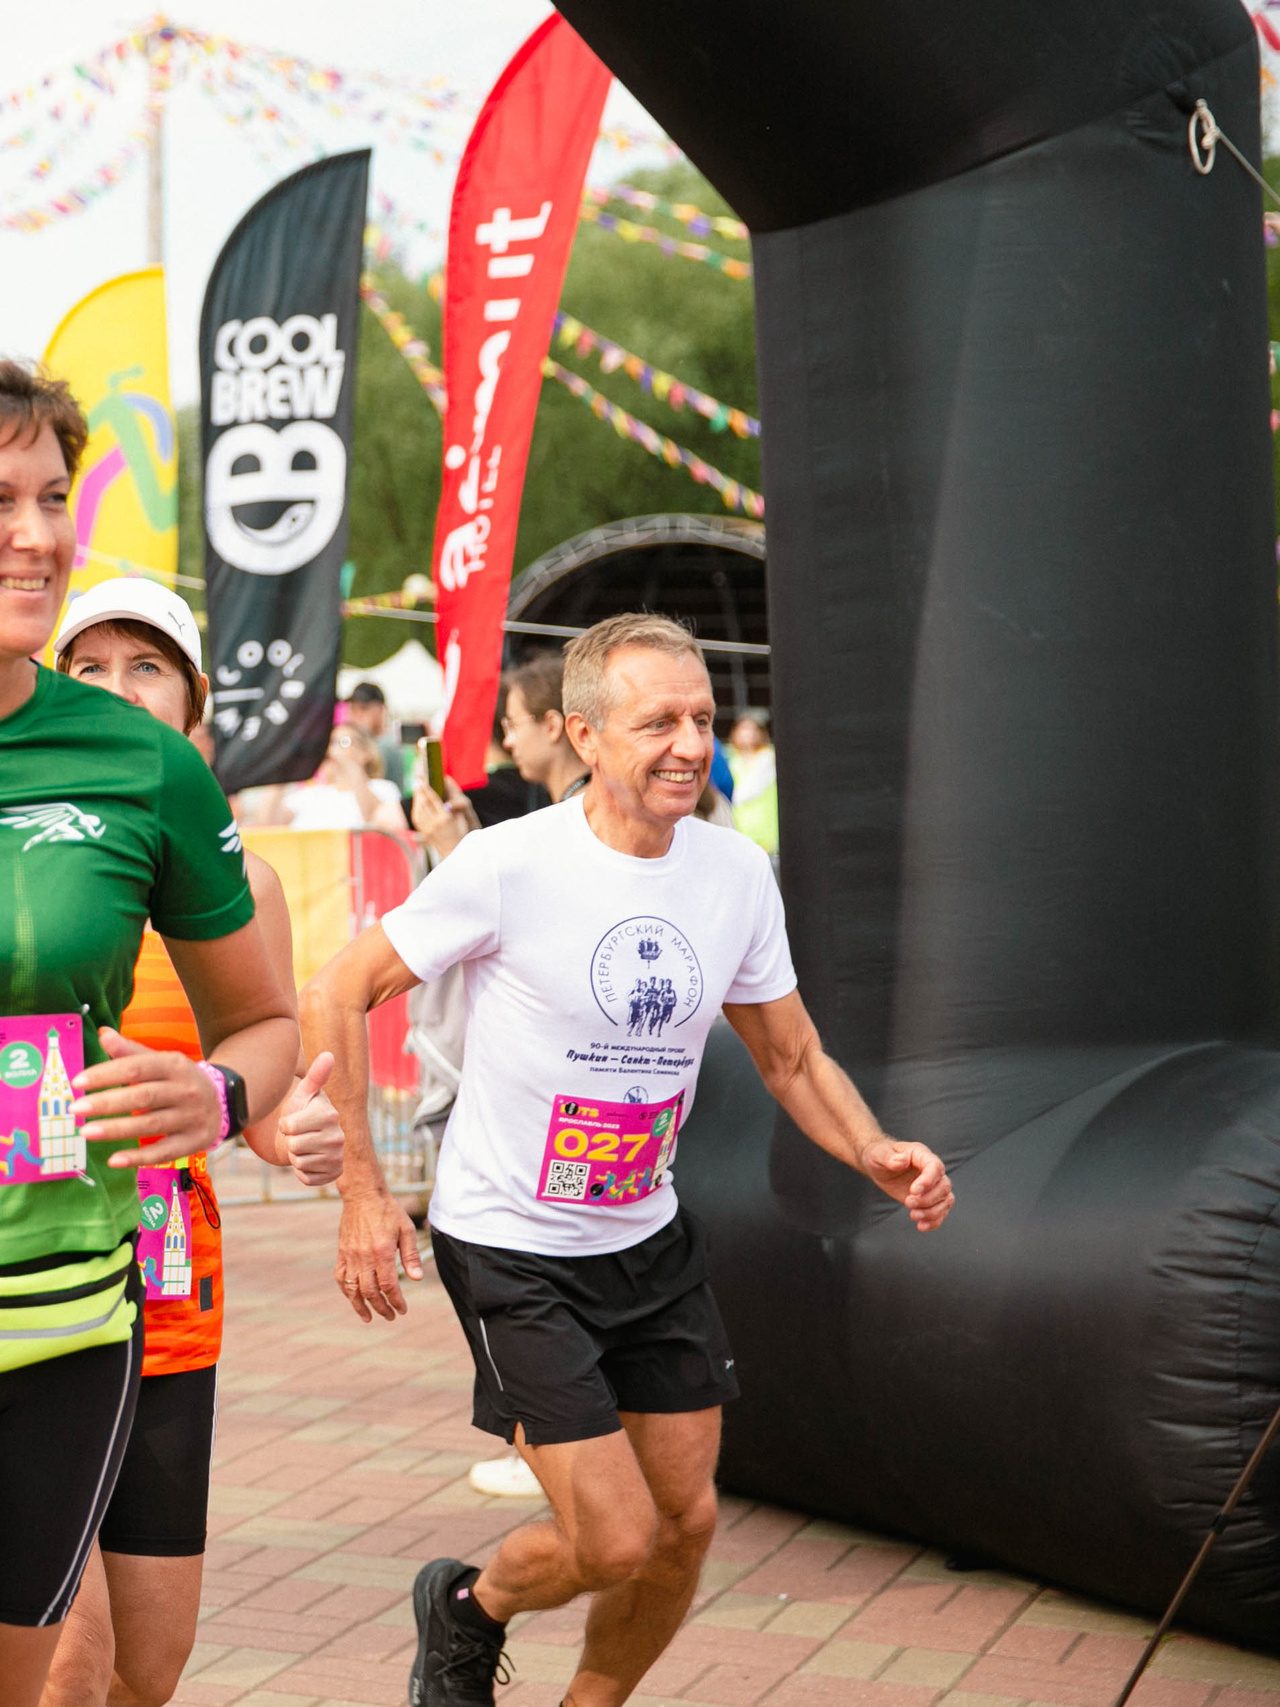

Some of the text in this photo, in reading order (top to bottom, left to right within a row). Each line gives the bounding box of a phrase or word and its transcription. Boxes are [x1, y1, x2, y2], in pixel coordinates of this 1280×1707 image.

[214, 314, 345, 371] COOL
[210, 361, 344, 426] BREW
[598, 924, 698, 1007] ПЕТЕРБУРГСКИЙ МАРАФОН
[9, 1048, 30, 1069] 2
[553, 1128, 651, 1162] 027
[149, 1202, 164, 1220] 2
